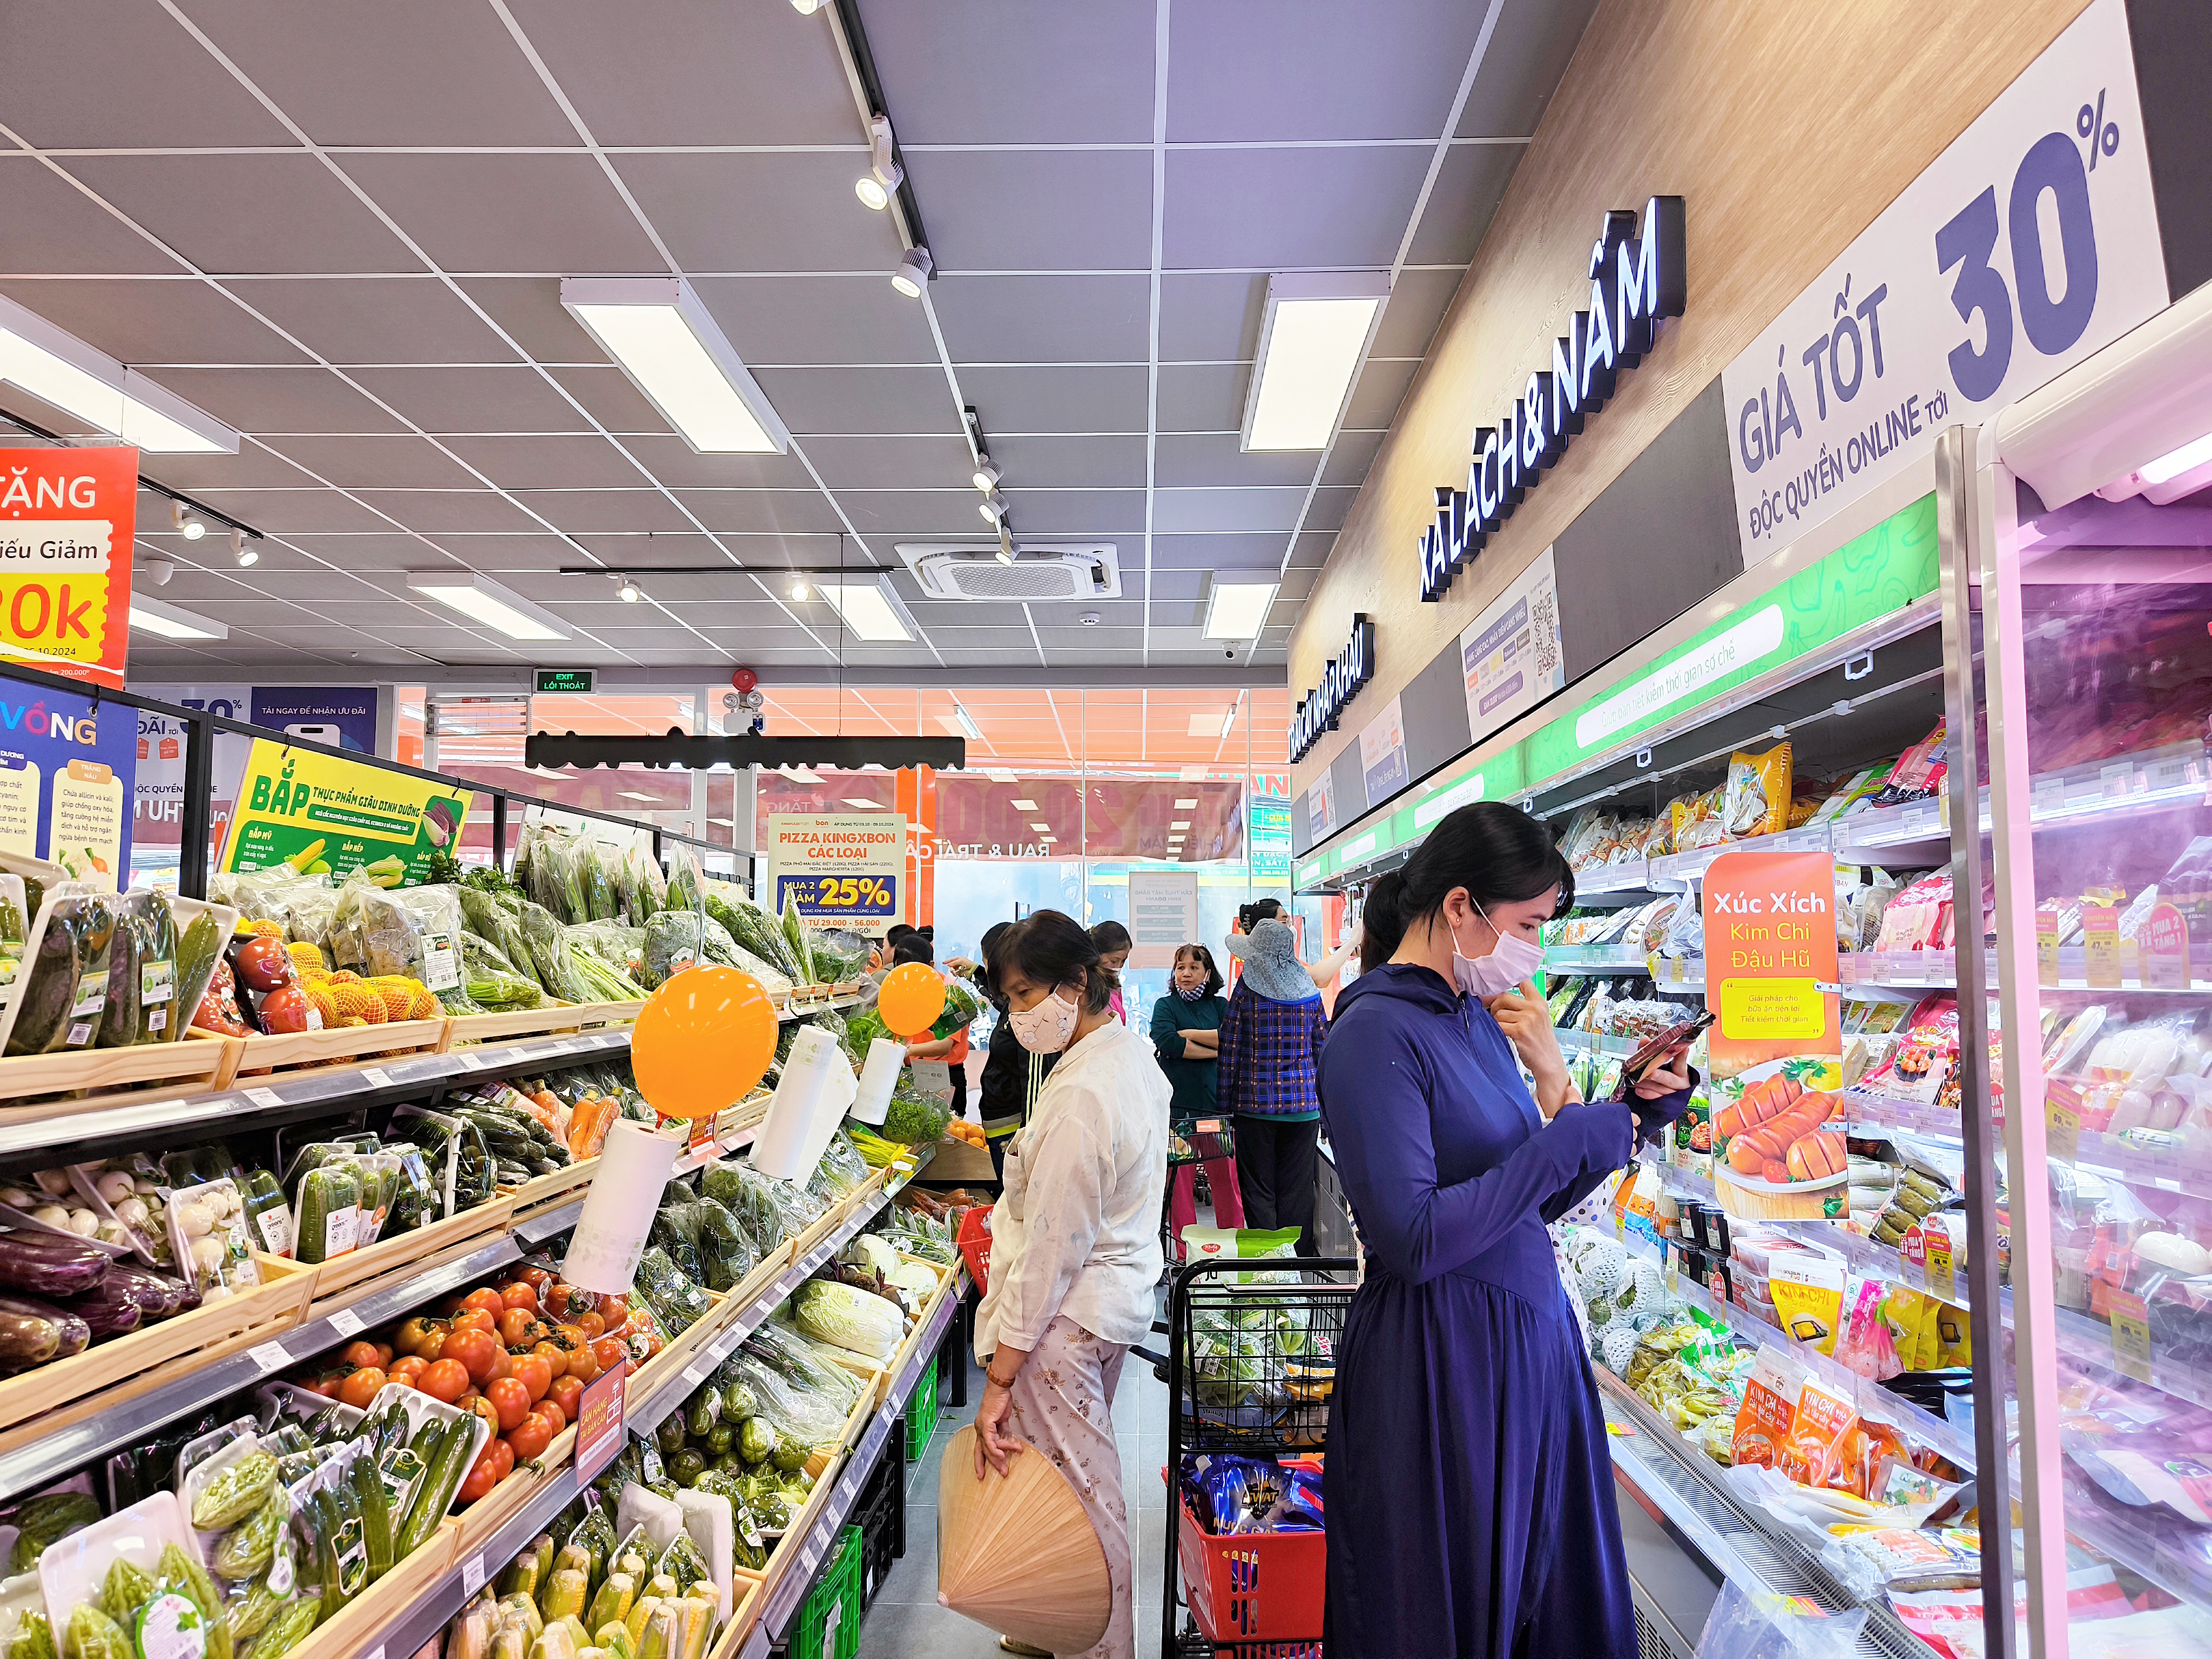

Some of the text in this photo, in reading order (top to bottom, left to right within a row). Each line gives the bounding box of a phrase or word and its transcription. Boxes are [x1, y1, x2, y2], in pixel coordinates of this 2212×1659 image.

[1739, 345, 1802, 474] GIÁ
[1802, 273, 1888, 421] TỐT
[1418, 197, 1657, 603] XÀ LÁCH & NẤM
[1750, 388, 1948, 539] ĐỘC QUYỀN ONLINE TỚI
[0, 538, 98, 559] iếu Giảm
[0, 583, 92, 639] 0k
[544, 680, 585, 690] LỐI THOÁT
[1602, 707, 1616, 728] Giúp
[1633, 691, 1644, 711] tiết
[1665, 669, 1682, 694] thời
[1684, 663, 1703, 689] gian
[1705, 653, 1716, 673] sơ
[1718, 637, 1735, 666] chế
[299, 706, 312, 715] ĐỂ
[313, 706, 336, 716] NHẬN
[352, 706, 366, 715] ĐÃI
[78, 791, 95, 800] allicin
[152, 783, 183, 793] QUYỀN
[249, 759, 311, 817] BẮP
[3, 804, 18, 813] nguy
[61, 800, 74, 808] giúp
[75, 801, 91, 811] chống
[313, 787, 335, 803] THỰC
[335, 787, 358, 805] PHẨM
[379, 800, 398, 813] DINH
[398, 803, 421, 818] DƯỠNG
[8, 815, 18, 823] tim
[61, 811, 74, 820] tăng
[93, 814, 99, 823] hệ
[14, 826, 27, 835] kinh
[61, 821, 73, 831] dịch
[248, 826, 262, 839] BẮP
[74, 833, 88, 842] bệnh
[89, 835, 98, 843] tim
[99, 837, 113, 846] mạch
[342, 840, 353, 852] BẮP
[779, 832, 896, 844] PIZZA KINGXBON
[807, 844, 867, 860] CÁC LOẠI
[784, 881, 815, 890] MUA 2
[819, 878, 891, 907] 25%
[1714, 891, 1826, 913] Xúc Xích
[1730, 922, 1810, 940] Kim Chi
[2152, 915, 2180, 936] MUA 2
[2154, 932, 2181, 951] TẶNG 1
[1731, 949, 1810, 972] Đậu Hũ
[1765, 995, 1783, 1004] pháp
[1757, 1015, 1774, 1023] kiệm
[1776, 1015, 1790, 1023] thời
[1792, 1016, 1808, 1024] gian
[1991, 1094, 1999, 1107] UA
[1908, 1236, 1919, 1247] MUA
[1778, 1283, 1830, 1305] KIM CHI
[1750, 1384, 1764, 1404] KIM
[581, 1396, 608, 1427] CÂN HÀNG
[1818, 1398, 1836, 1415] CHI
[587, 1420, 596, 1436] BÀN
[597, 1411, 606, 1428] CÂN
